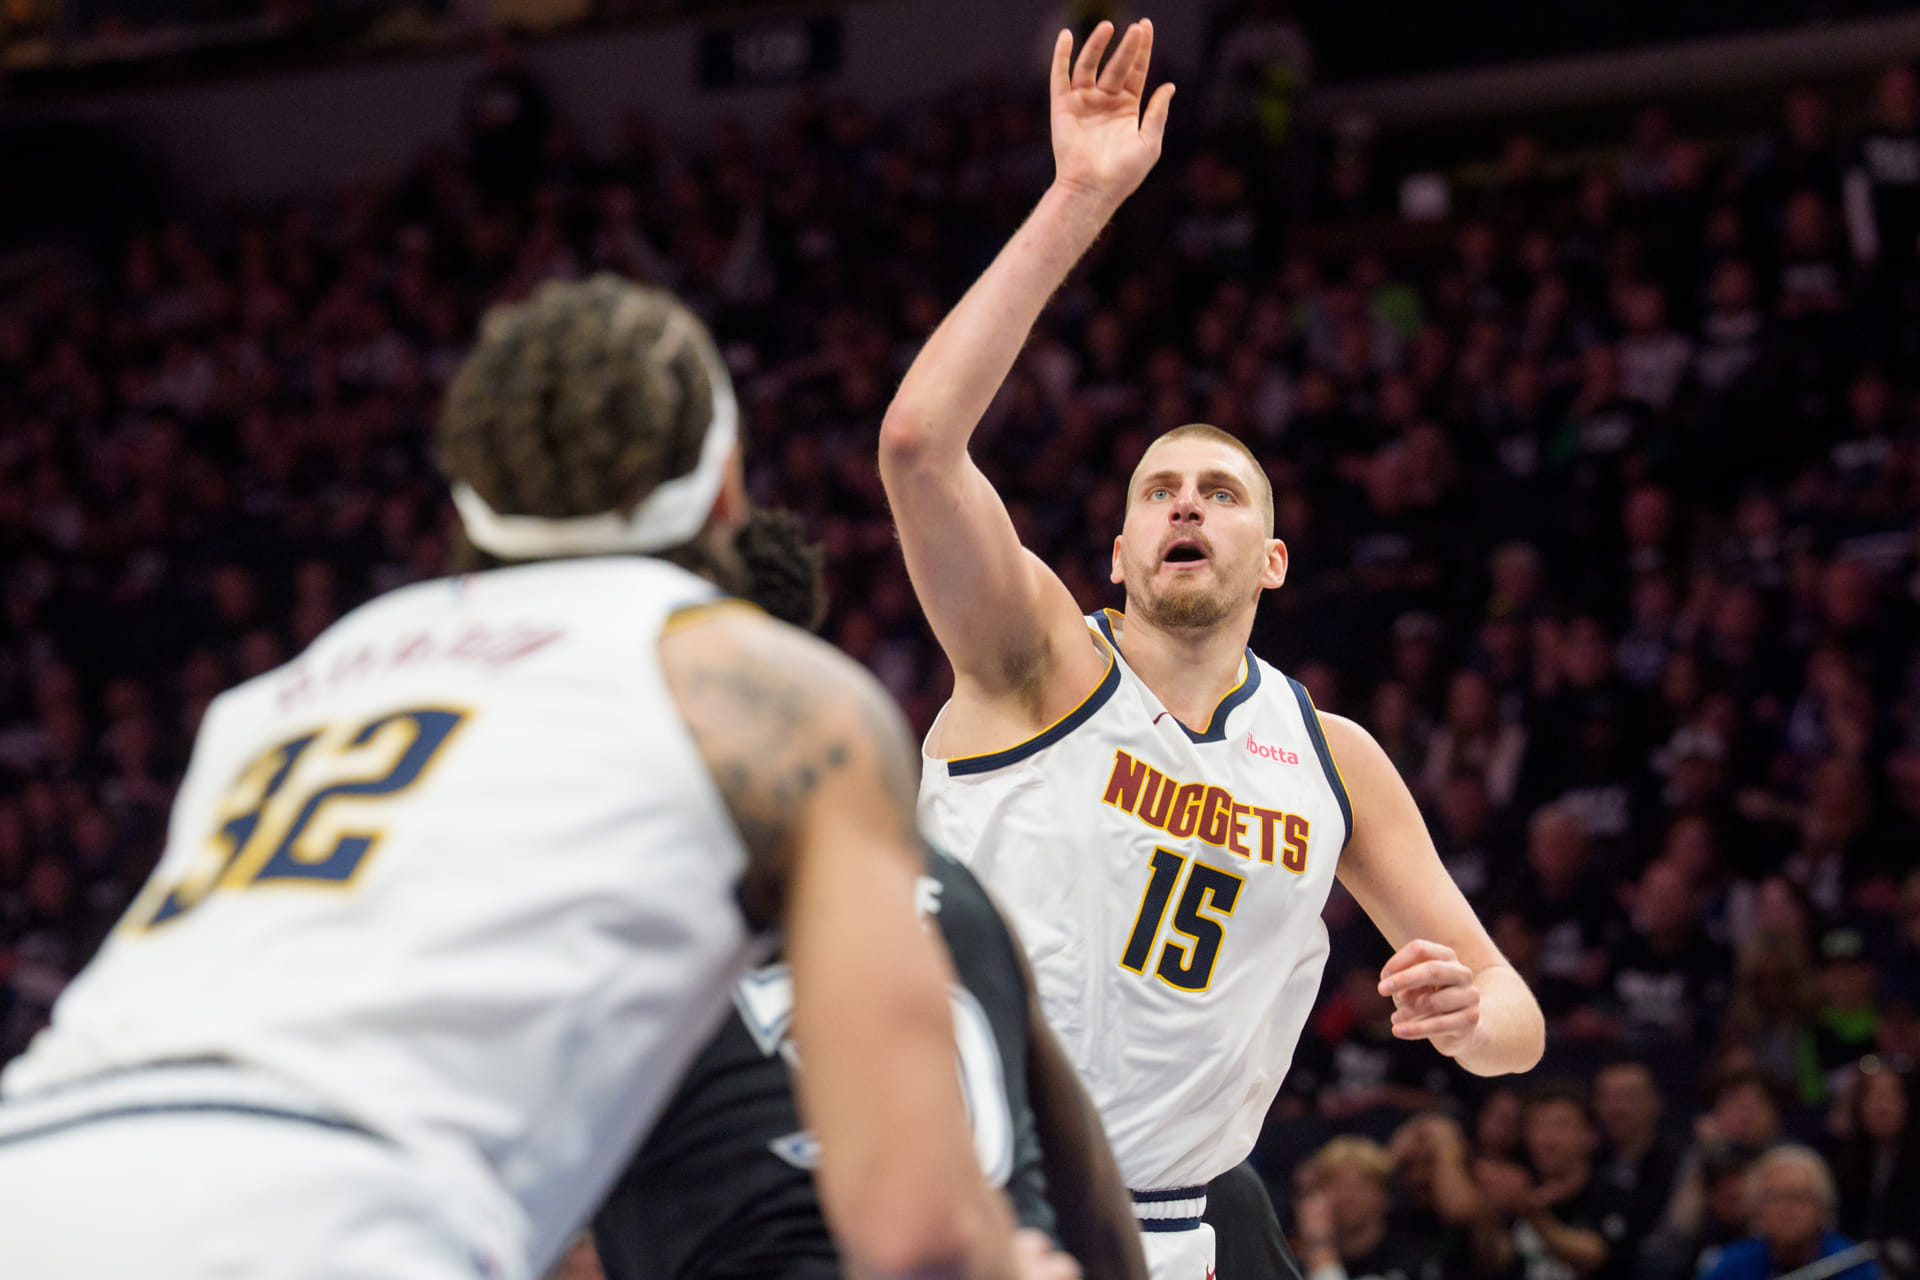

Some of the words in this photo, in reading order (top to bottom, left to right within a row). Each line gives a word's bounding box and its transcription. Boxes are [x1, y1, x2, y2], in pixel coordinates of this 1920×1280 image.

[1102, 748, 1310, 874] NUGGETS
[1246, 732, 1299, 765] ibotta
[1119, 845, 1246, 993] 15
